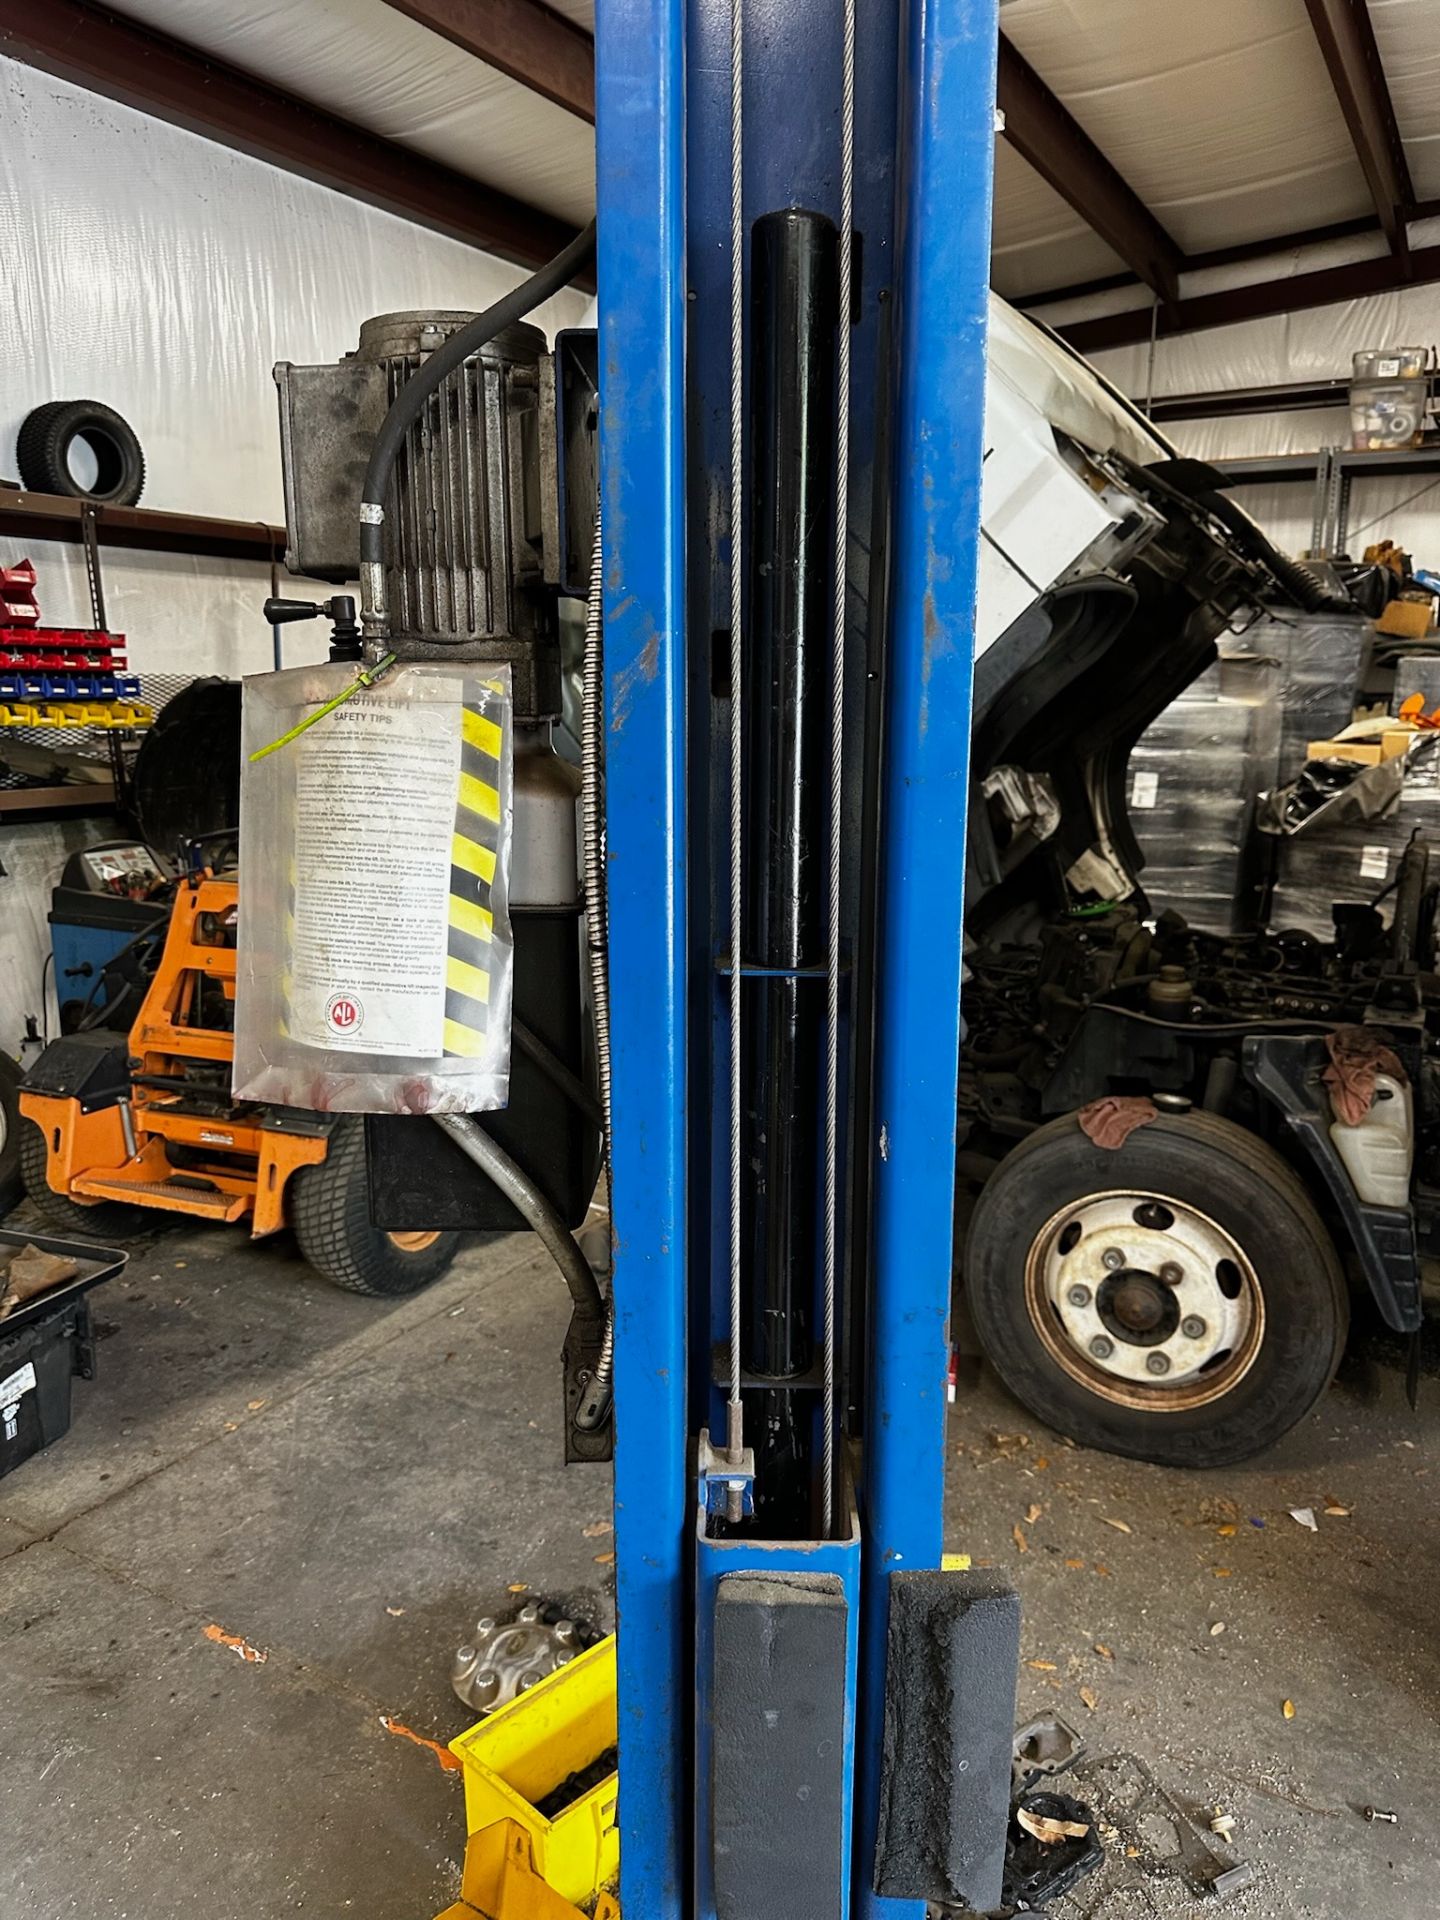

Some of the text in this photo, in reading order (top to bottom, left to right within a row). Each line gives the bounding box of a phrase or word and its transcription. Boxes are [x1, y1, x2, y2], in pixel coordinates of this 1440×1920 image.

[323, 692, 385, 707] MOTIVE
[334, 712, 392, 724] SAFETY TIPS
[334, 1002, 353, 1025] ALI
